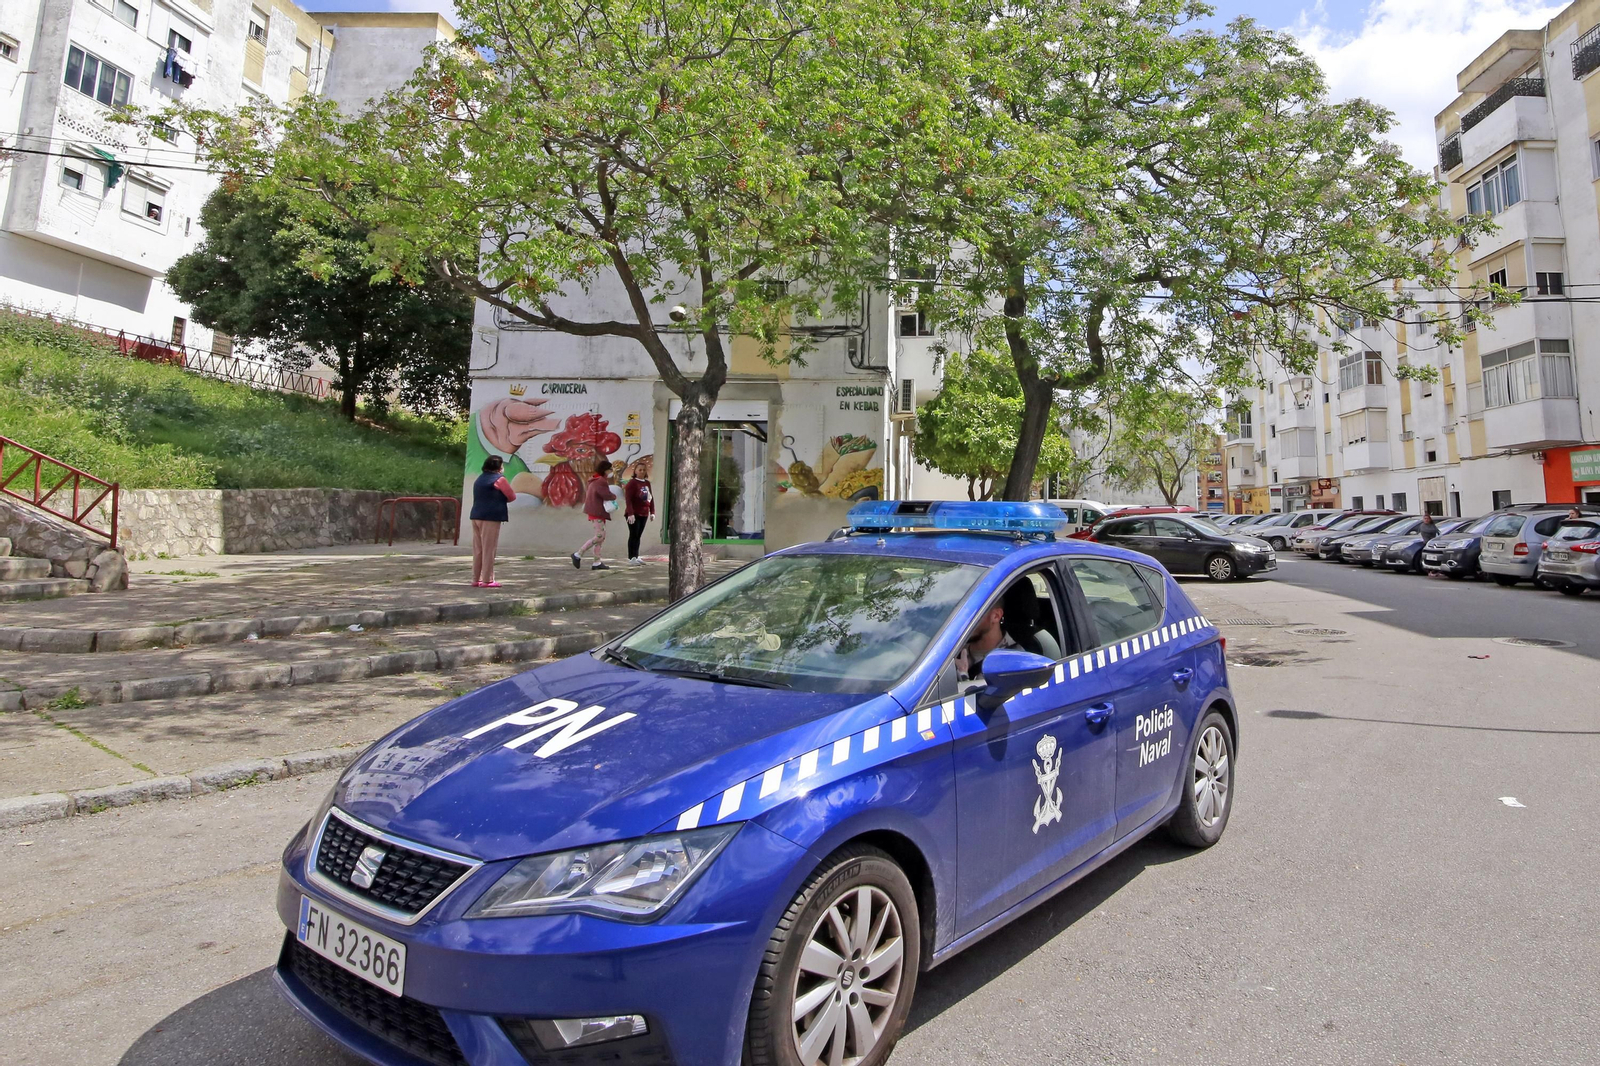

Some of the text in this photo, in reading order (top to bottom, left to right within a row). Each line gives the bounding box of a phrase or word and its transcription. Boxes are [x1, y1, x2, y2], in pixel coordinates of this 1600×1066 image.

[541, 383, 587, 394] CARNICERIA
[840, 401, 879, 411] EN KEBAB
[462, 698, 637, 759] PN
[1135, 704, 1173, 741] Policía
[1139, 730, 1171, 768] Naval
[815, 864, 861, 910] MICHELIN
[307, 906, 400, 985] FN 32366
